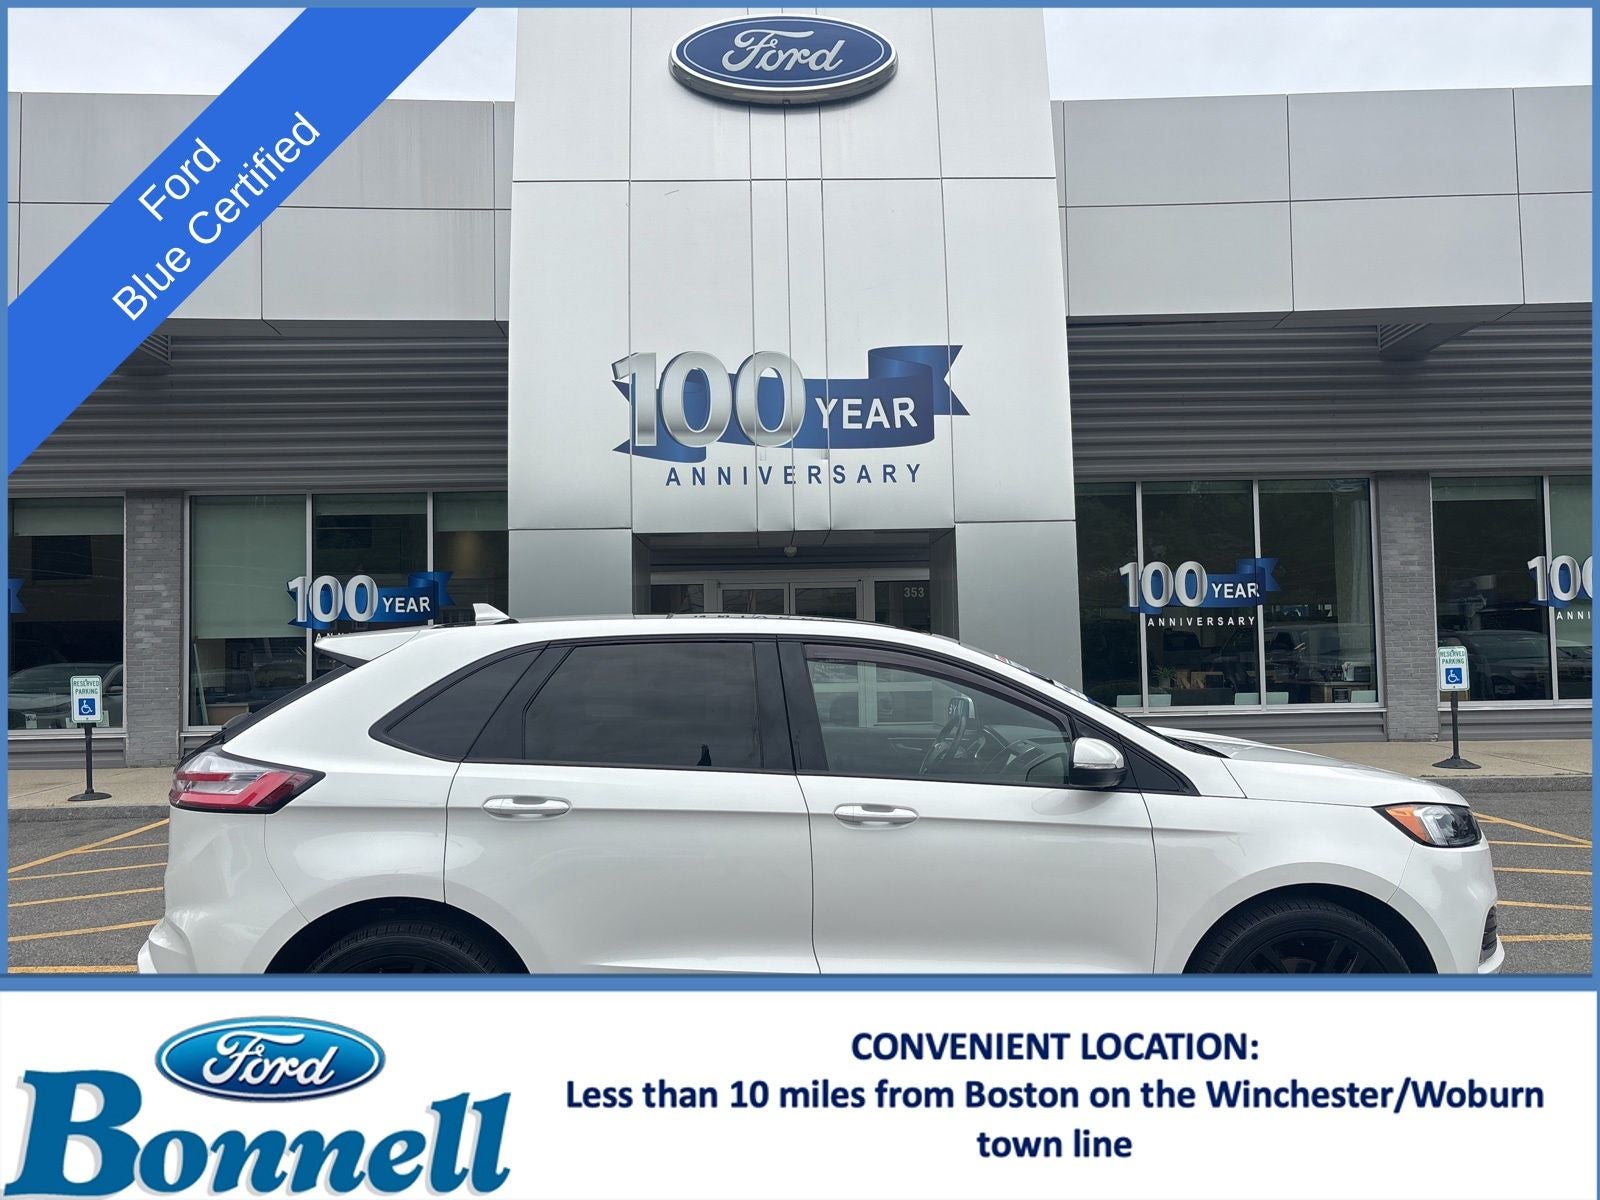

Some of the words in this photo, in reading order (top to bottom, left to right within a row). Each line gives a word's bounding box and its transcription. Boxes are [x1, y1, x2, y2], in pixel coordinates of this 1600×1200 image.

[721, 28, 846, 73] Ford
[611, 350, 806, 448] 100
[815, 397, 918, 430] YEAR
[665, 464, 921, 487] ANNIVERSARY
[287, 574, 379, 623] 100
[382, 596, 431, 613] YEAR
[903, 586, 925, 598] 353
[1119, 560, 1208, 608] 100
[1212, 582, 1260, 599] YEAR
[1147, 616, 1255, 627] ANNIVERSARY
